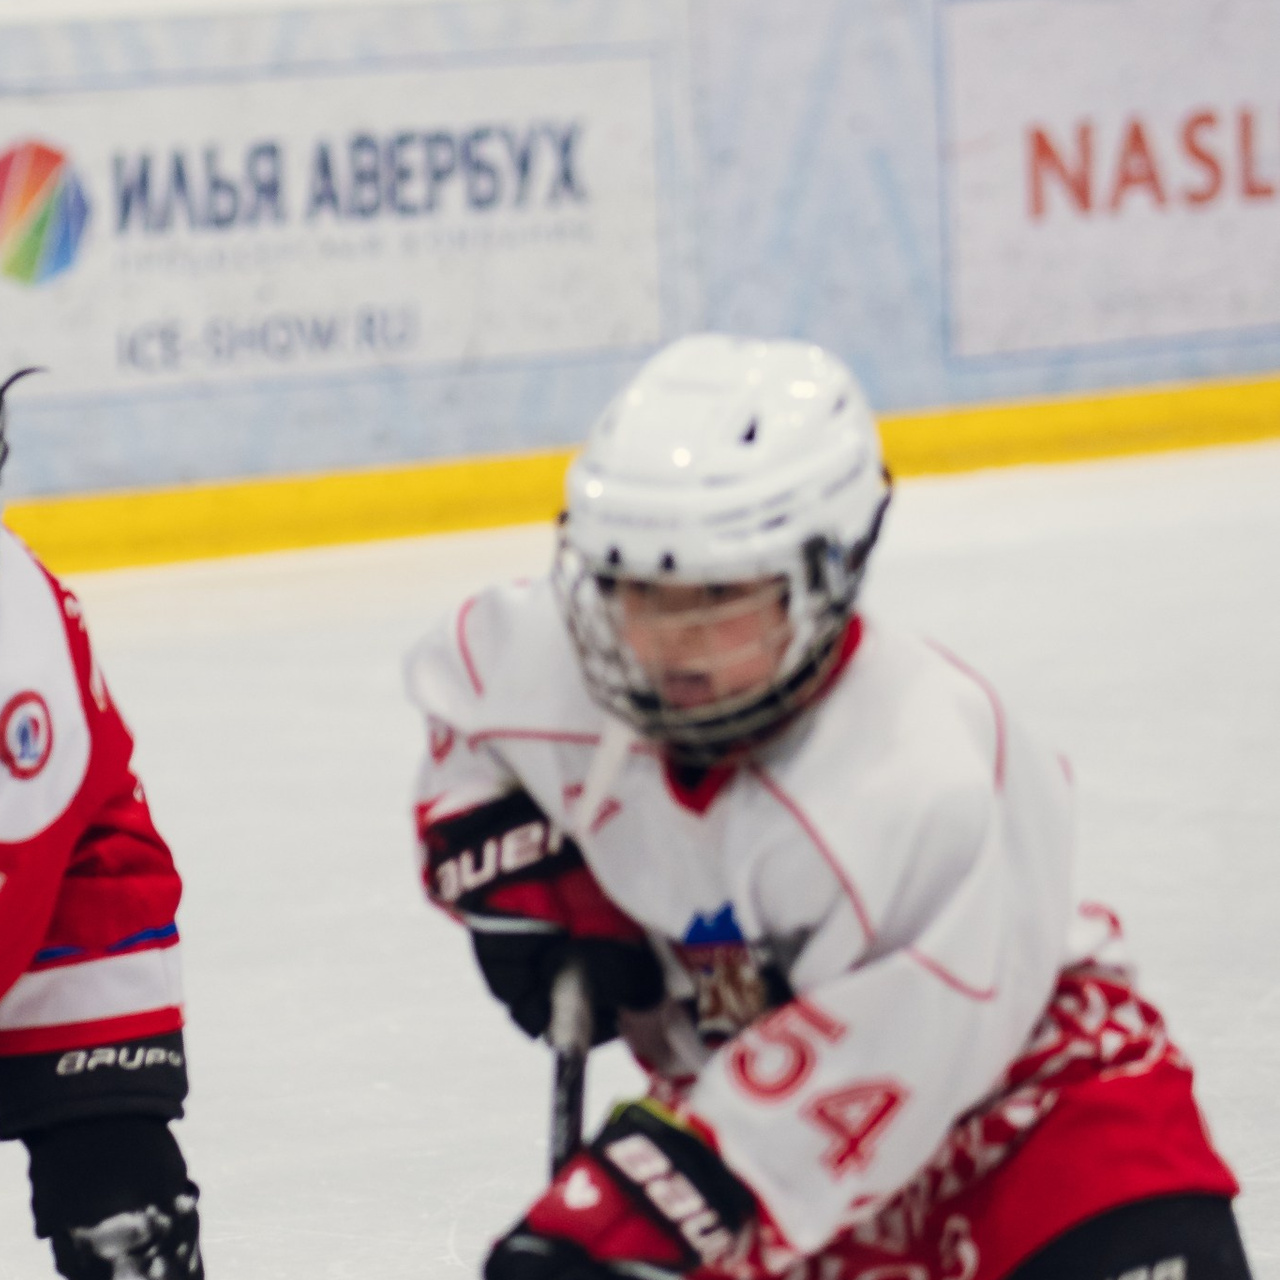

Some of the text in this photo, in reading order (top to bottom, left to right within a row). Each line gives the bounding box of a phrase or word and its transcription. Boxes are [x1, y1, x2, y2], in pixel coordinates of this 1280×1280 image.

[110, 118, 586, 233] ИЛЬЯ АВЕРБУХ
[726, 996, 907, 1178] 54
